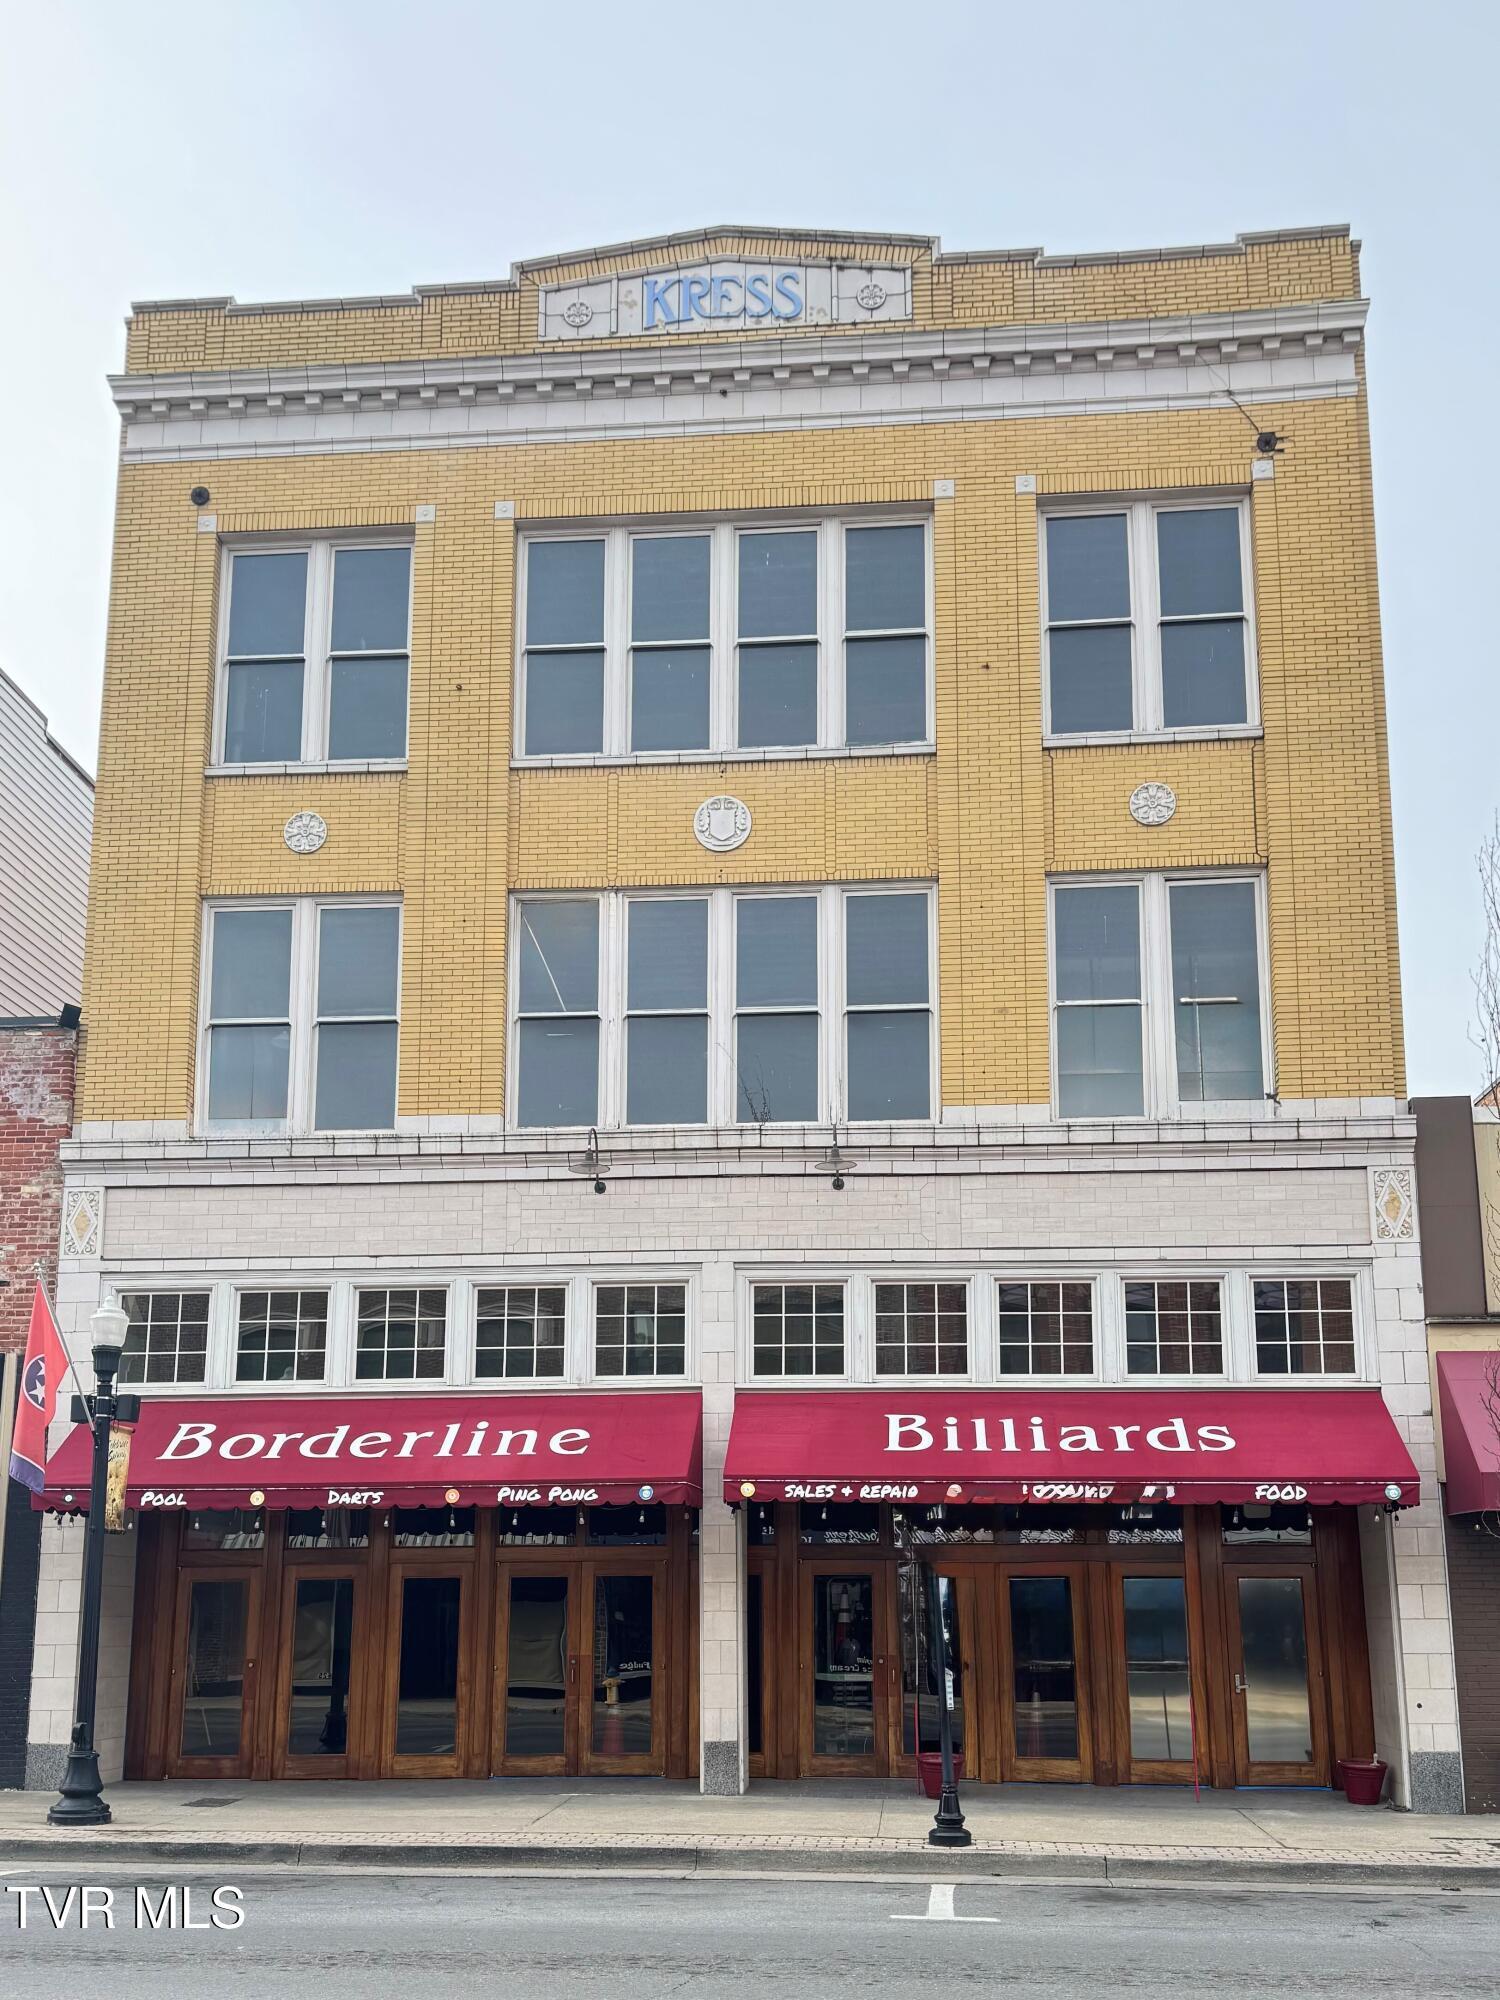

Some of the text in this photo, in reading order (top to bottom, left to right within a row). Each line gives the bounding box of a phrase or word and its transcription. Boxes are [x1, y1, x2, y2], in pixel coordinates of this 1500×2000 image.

[643, 271, 804, 329] KRESS
[155, 1421, 591, 1460] Borderline
[884, 1414, 1237, 1451] Billiards
[328, 1490, 384, 1504] DARTS
[784, 1485, 836, 1498] SALES
[1255, 1485, 1307, 1500] FOOD
